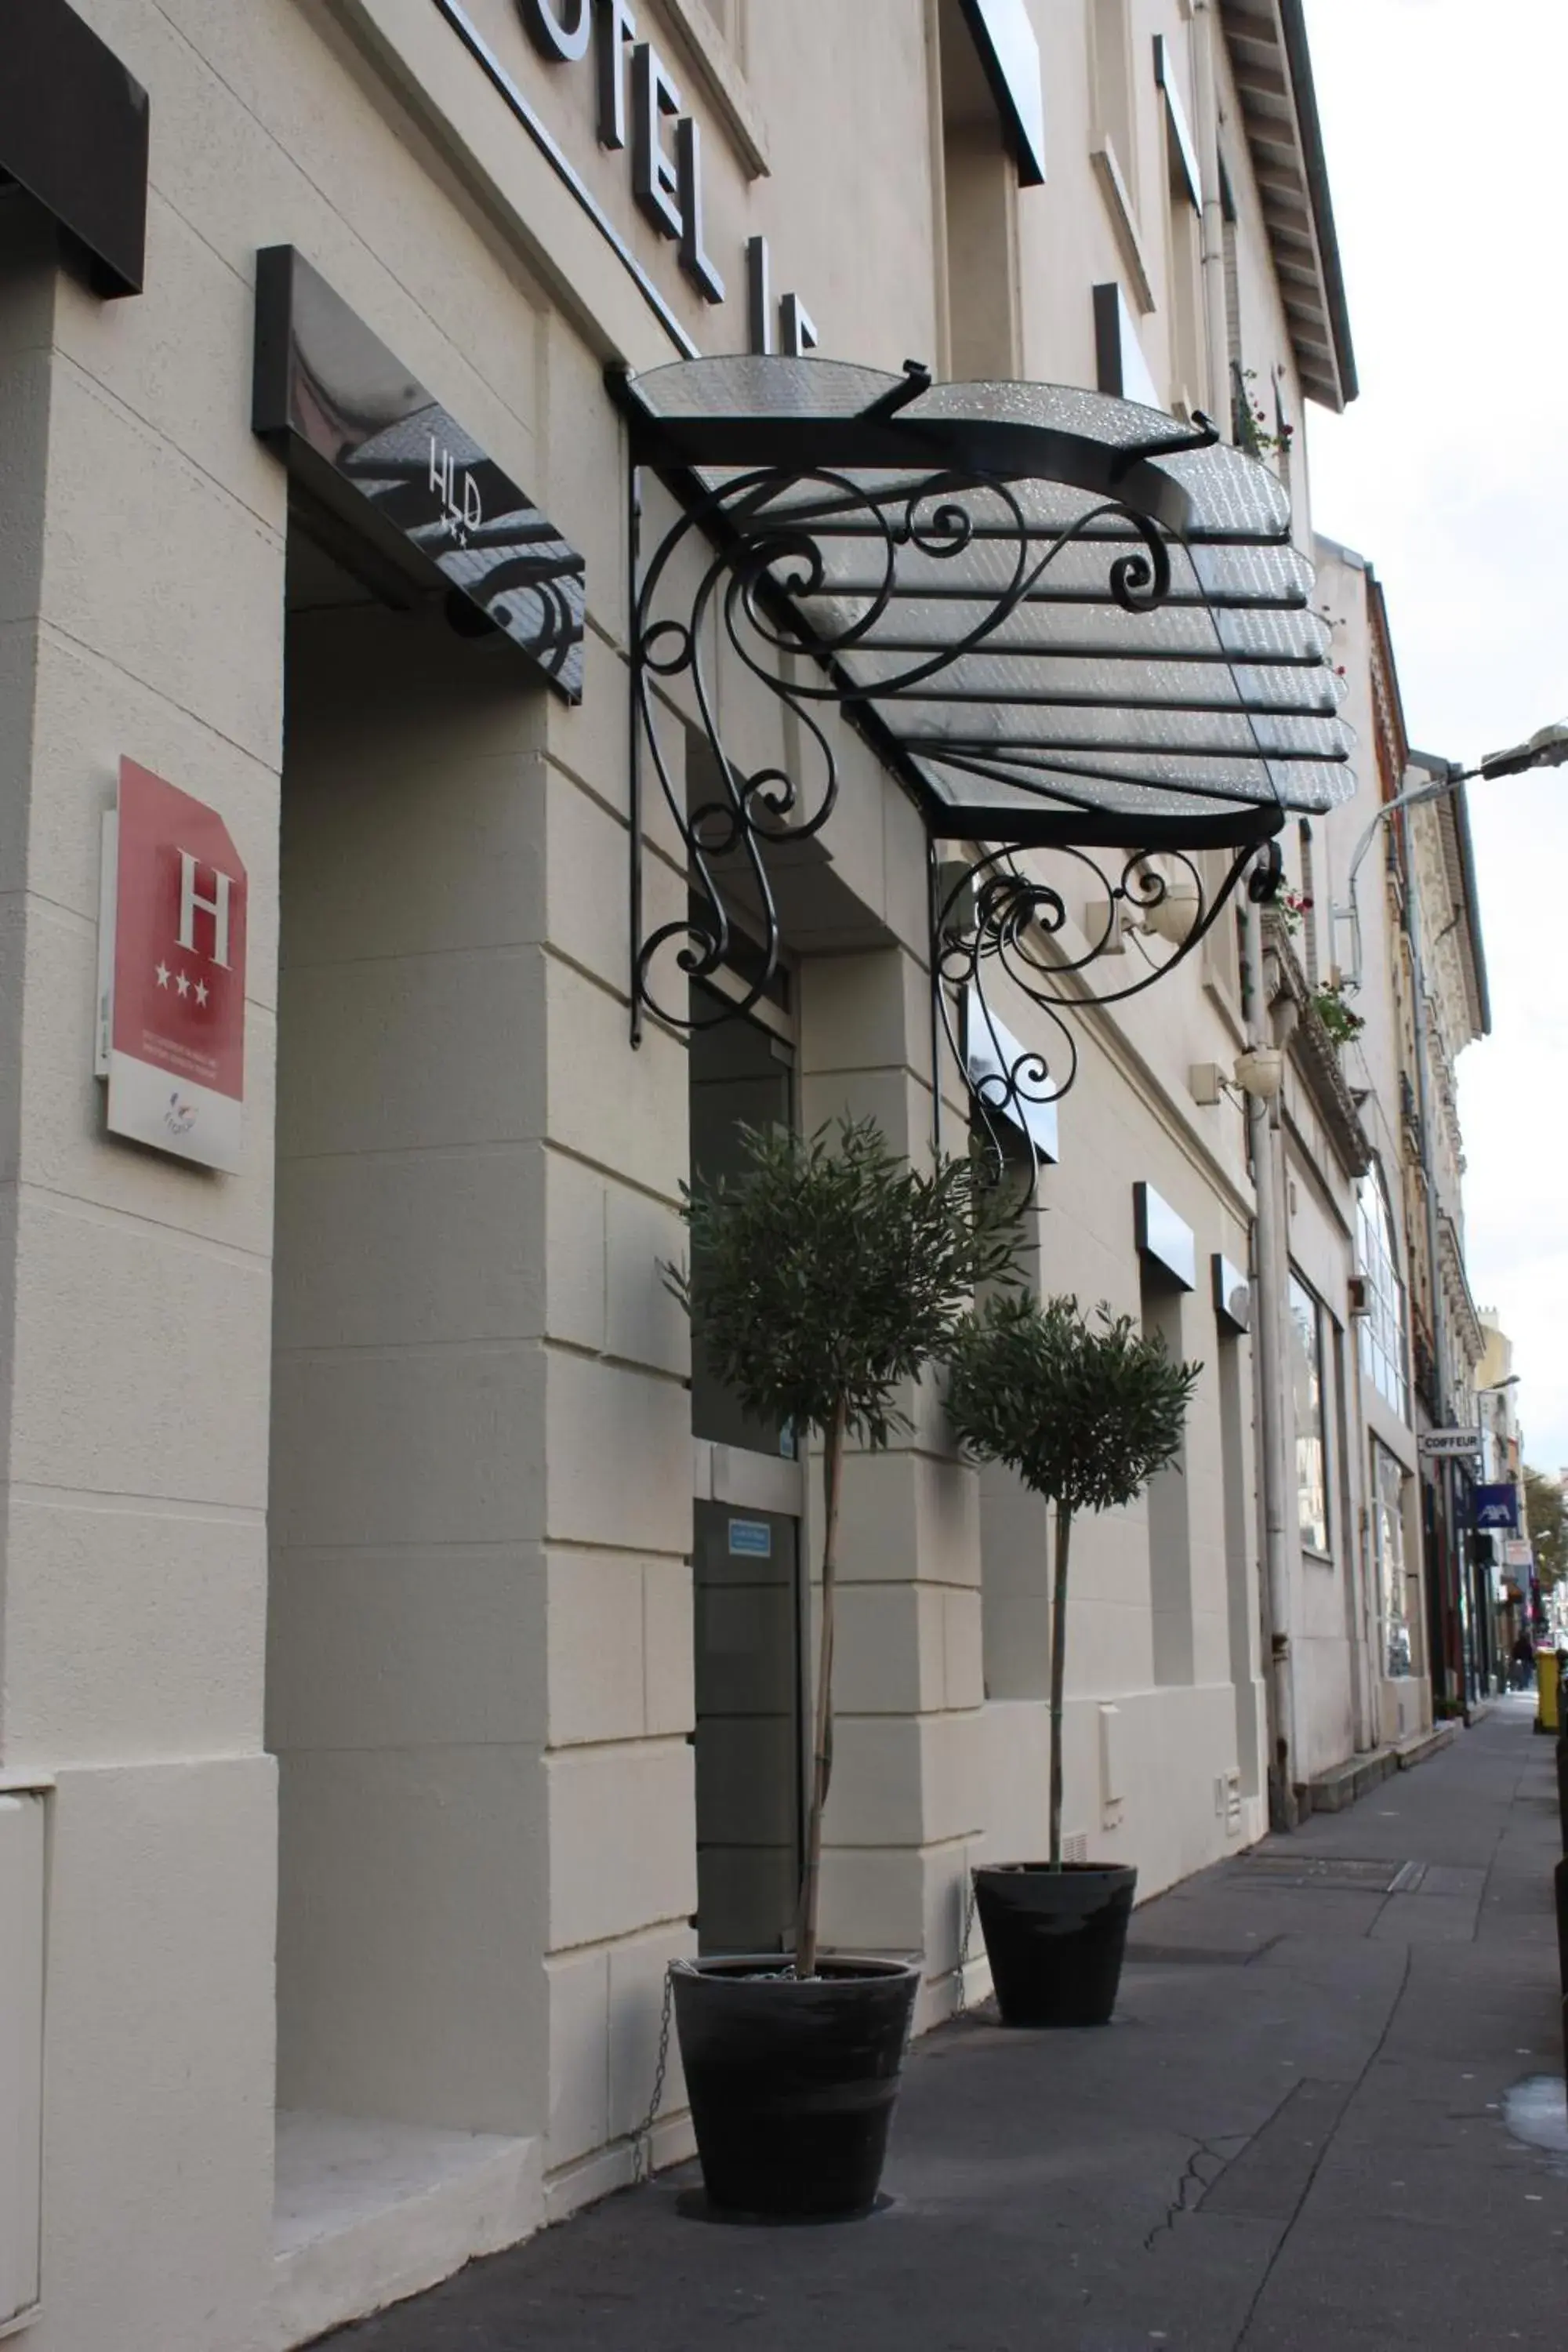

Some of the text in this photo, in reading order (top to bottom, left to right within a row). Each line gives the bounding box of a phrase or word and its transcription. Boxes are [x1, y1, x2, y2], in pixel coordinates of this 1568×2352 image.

[430, 436, 482, 531] HLD
[175, 847, 235, 971] H
[1425, 1436, 1477, 1448] COIFFEUR
[1477, 1504, 1512, 1522] AXA
